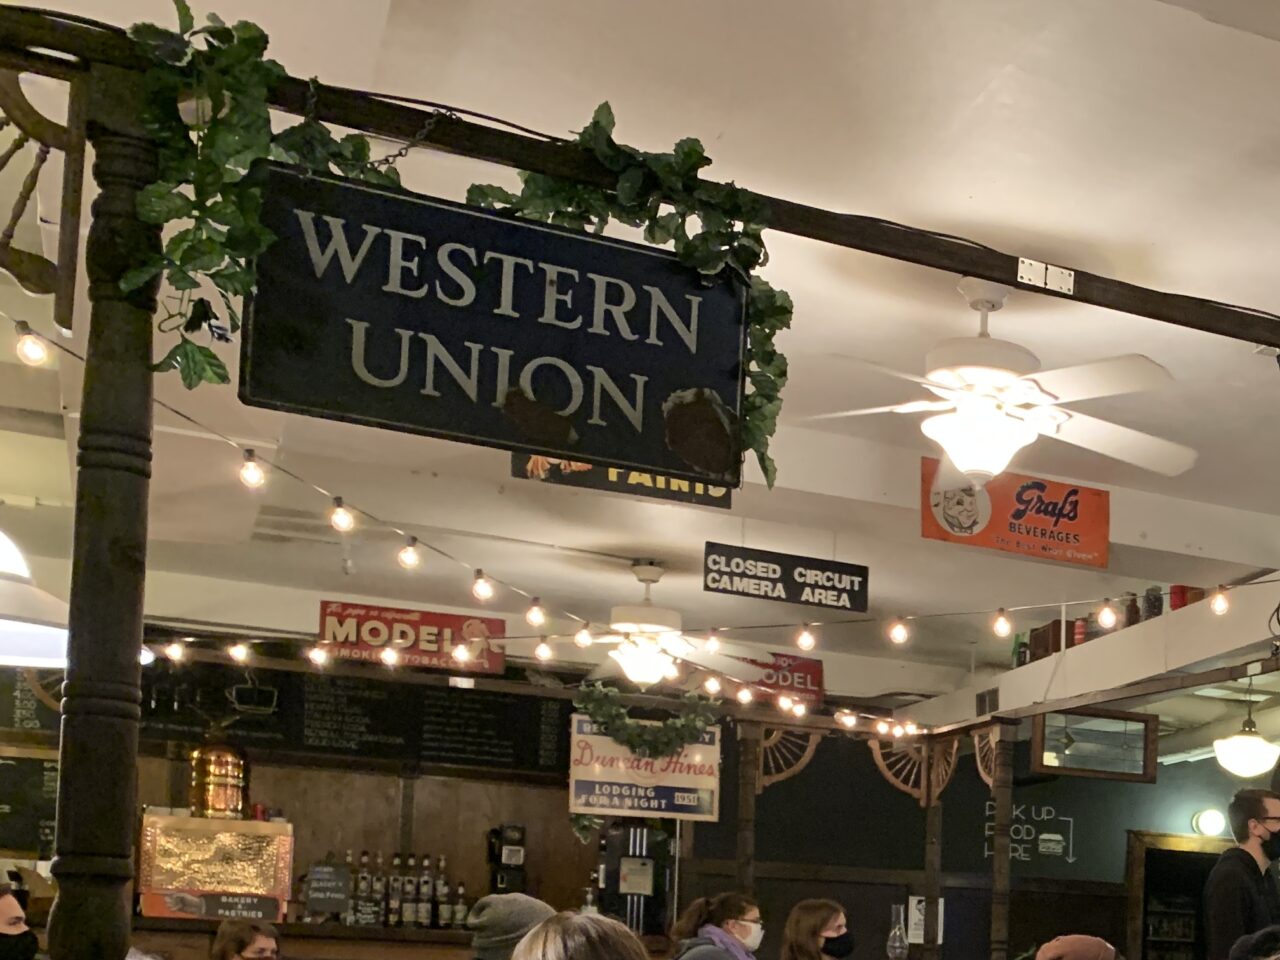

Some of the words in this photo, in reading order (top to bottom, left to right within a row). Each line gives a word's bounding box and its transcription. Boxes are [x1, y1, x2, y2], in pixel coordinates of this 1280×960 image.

[294, 209, 702, 354] WESTERN
[346, 318, 648, 434] UNION
[1008, 521, 1080, 544] BEVERAGES
[707, 554, 781, 579] CLOSED
[794, 567, 862, 591] CIRCUIT
[706, 572, 786, 599] CAMERA
[801, 586, 851, 608] AREA
[324, 616, 459, 653] MODEL
[762, 668, 818, 690] ODEL
[573, 739, 657, 774] Duncan
[660, 746, 716, 777] Hines
[578, 795, 610, 806] FOR
[612, 797, 621, 806] A
[623, 799, 667, 809] NIGHT
[595, 784, 656, 798] LODGING
[985, 801, 1026, 820] PK
[1031, 805, 1056, 821] UP
[985, 822, 1035, 840] FOD
[984, 841, 1031, 861] HRE
[221, 895, 258, 904] BAKERY
[218, 909, 263, 919] PASTRIES
